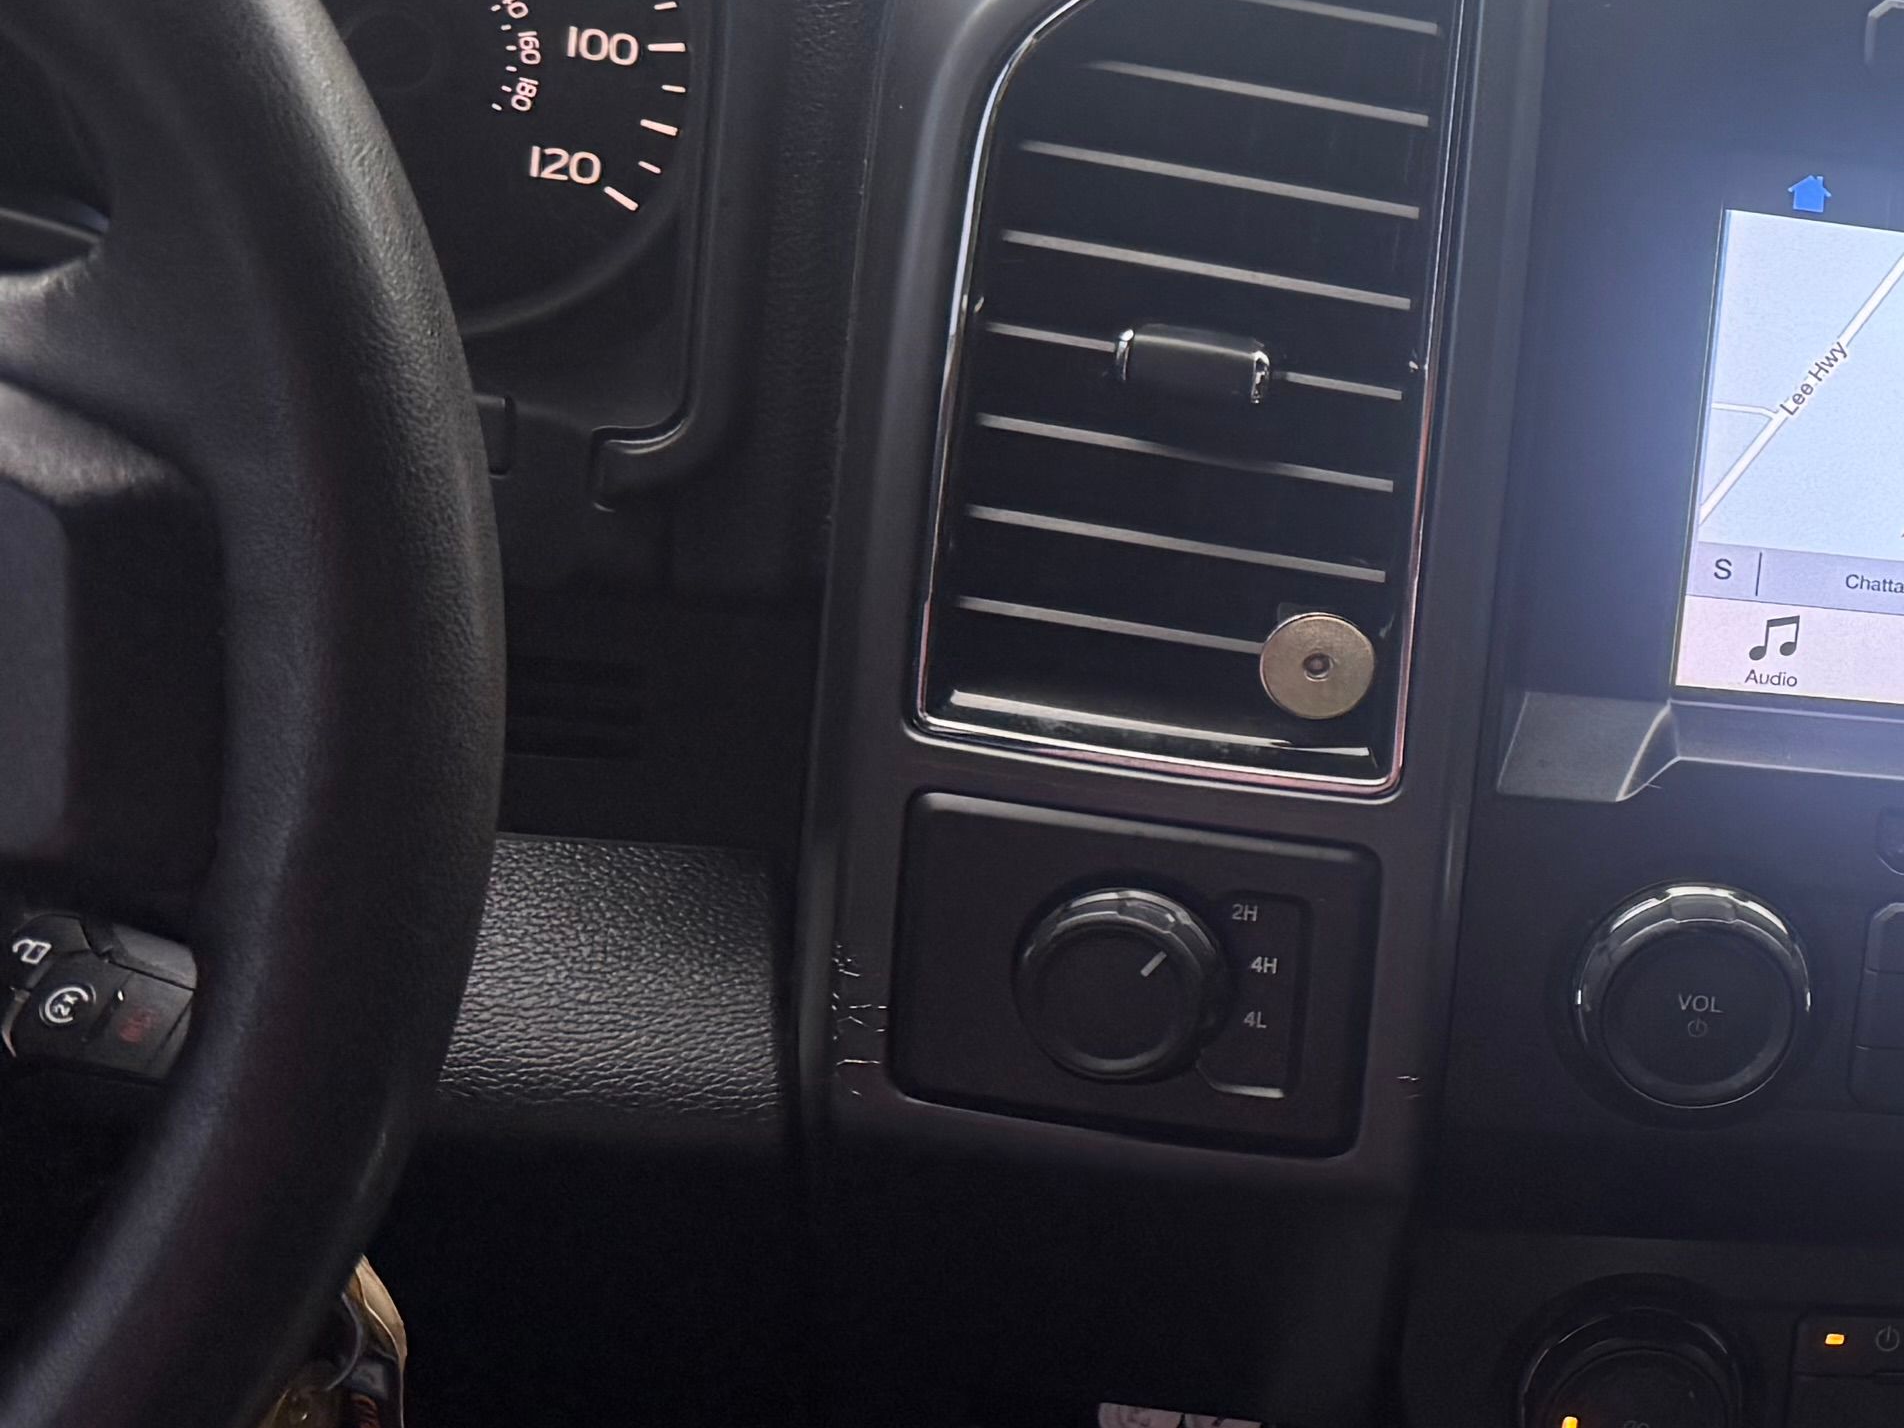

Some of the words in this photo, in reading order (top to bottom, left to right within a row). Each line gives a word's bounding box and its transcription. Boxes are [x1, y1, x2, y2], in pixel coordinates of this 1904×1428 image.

[518, 31, 541, 65] 160
[567, 26, 638, 66] 100
[511, 77, 539, 112] 180
[530, 146, 601, 184] 120
[1780, 383, 1814, 415] Lee
[1808, 341, 1847, 382] Hwy
[1713, 558, 1733, 580] S
[1744, 669, 1798, 687] Audio
[1232, 903, 1258, 922] 2H
[1250, 956, 1278, 974] 4H
[1678, 993, 1724, 1013] VOL
[1243, 1011, 1267, 1029] 4L
